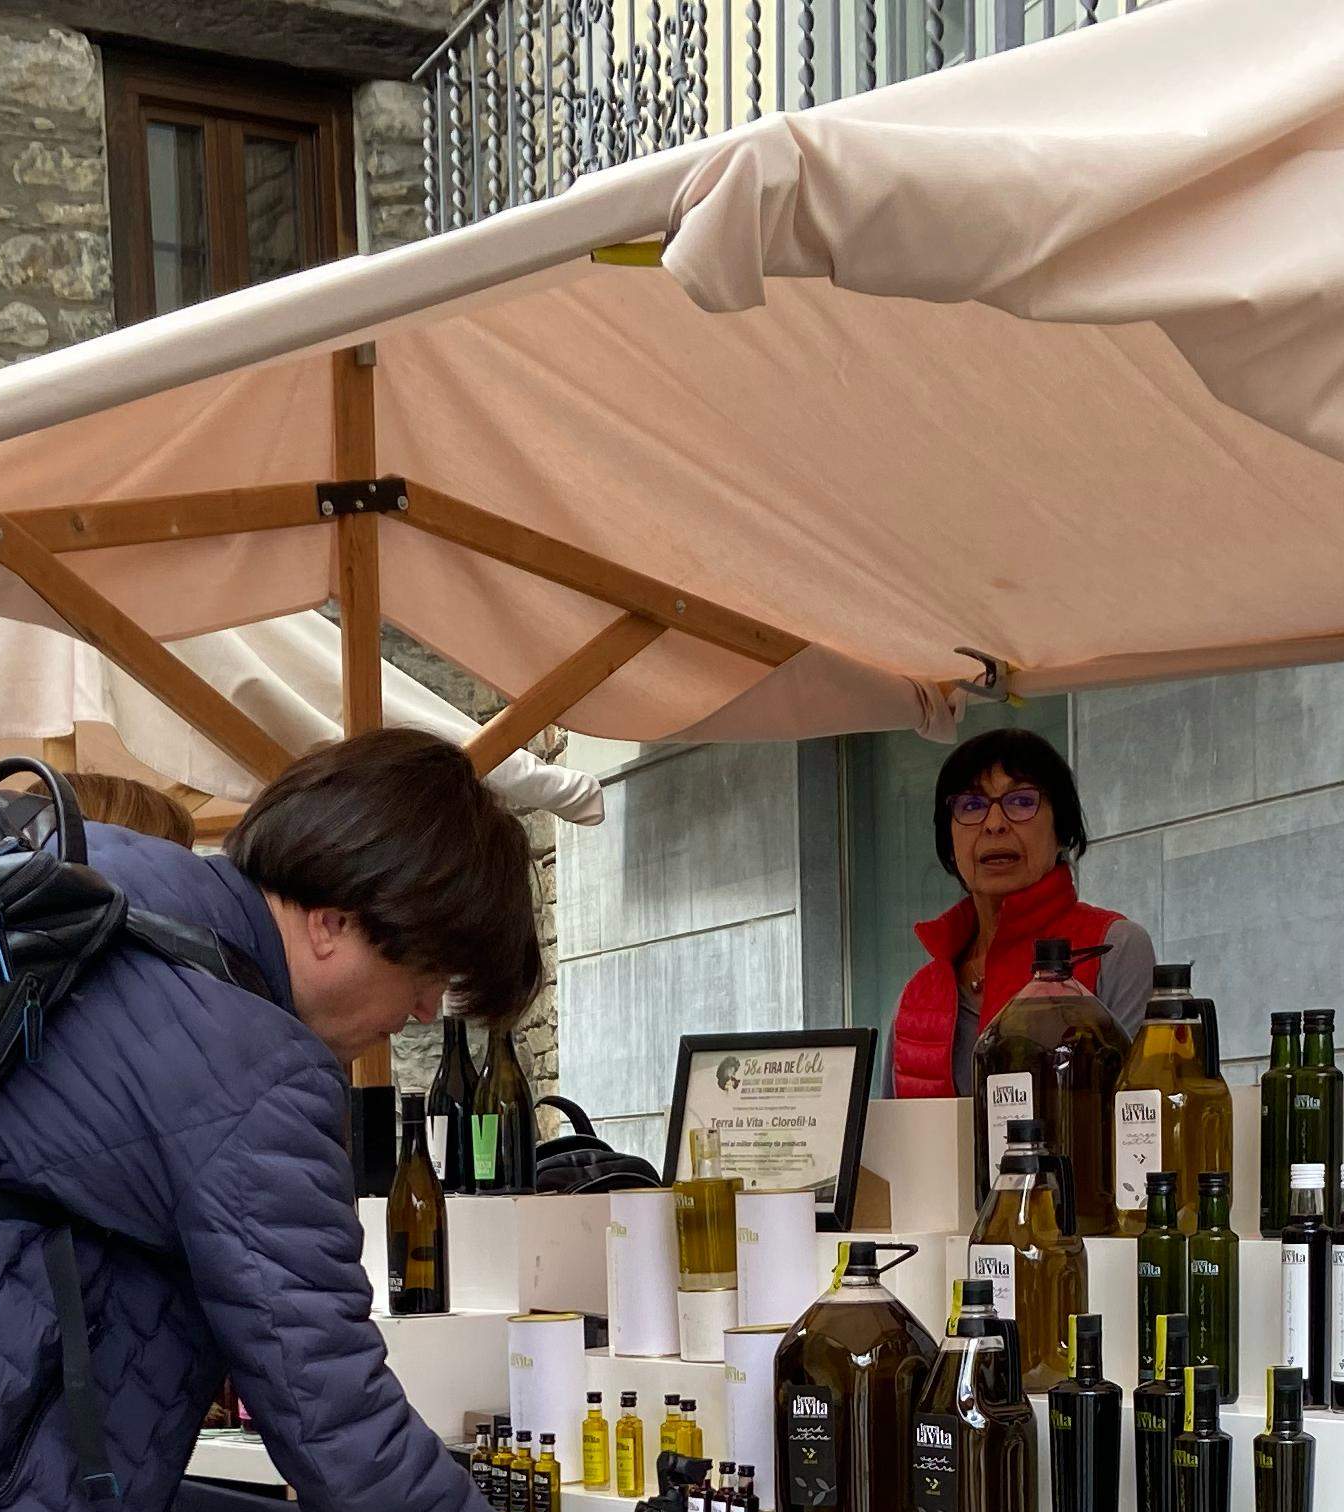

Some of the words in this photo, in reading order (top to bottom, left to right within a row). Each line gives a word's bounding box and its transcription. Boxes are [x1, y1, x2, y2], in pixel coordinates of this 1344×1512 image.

[764, 1062, 782, 1075] FIRA
[784, 1061, 795, 1074] DE
[711, 1118, 734, 1128] Terra
[736, 1117, 744, 1128] la
[746, 1117, 764, 1128] Vita
